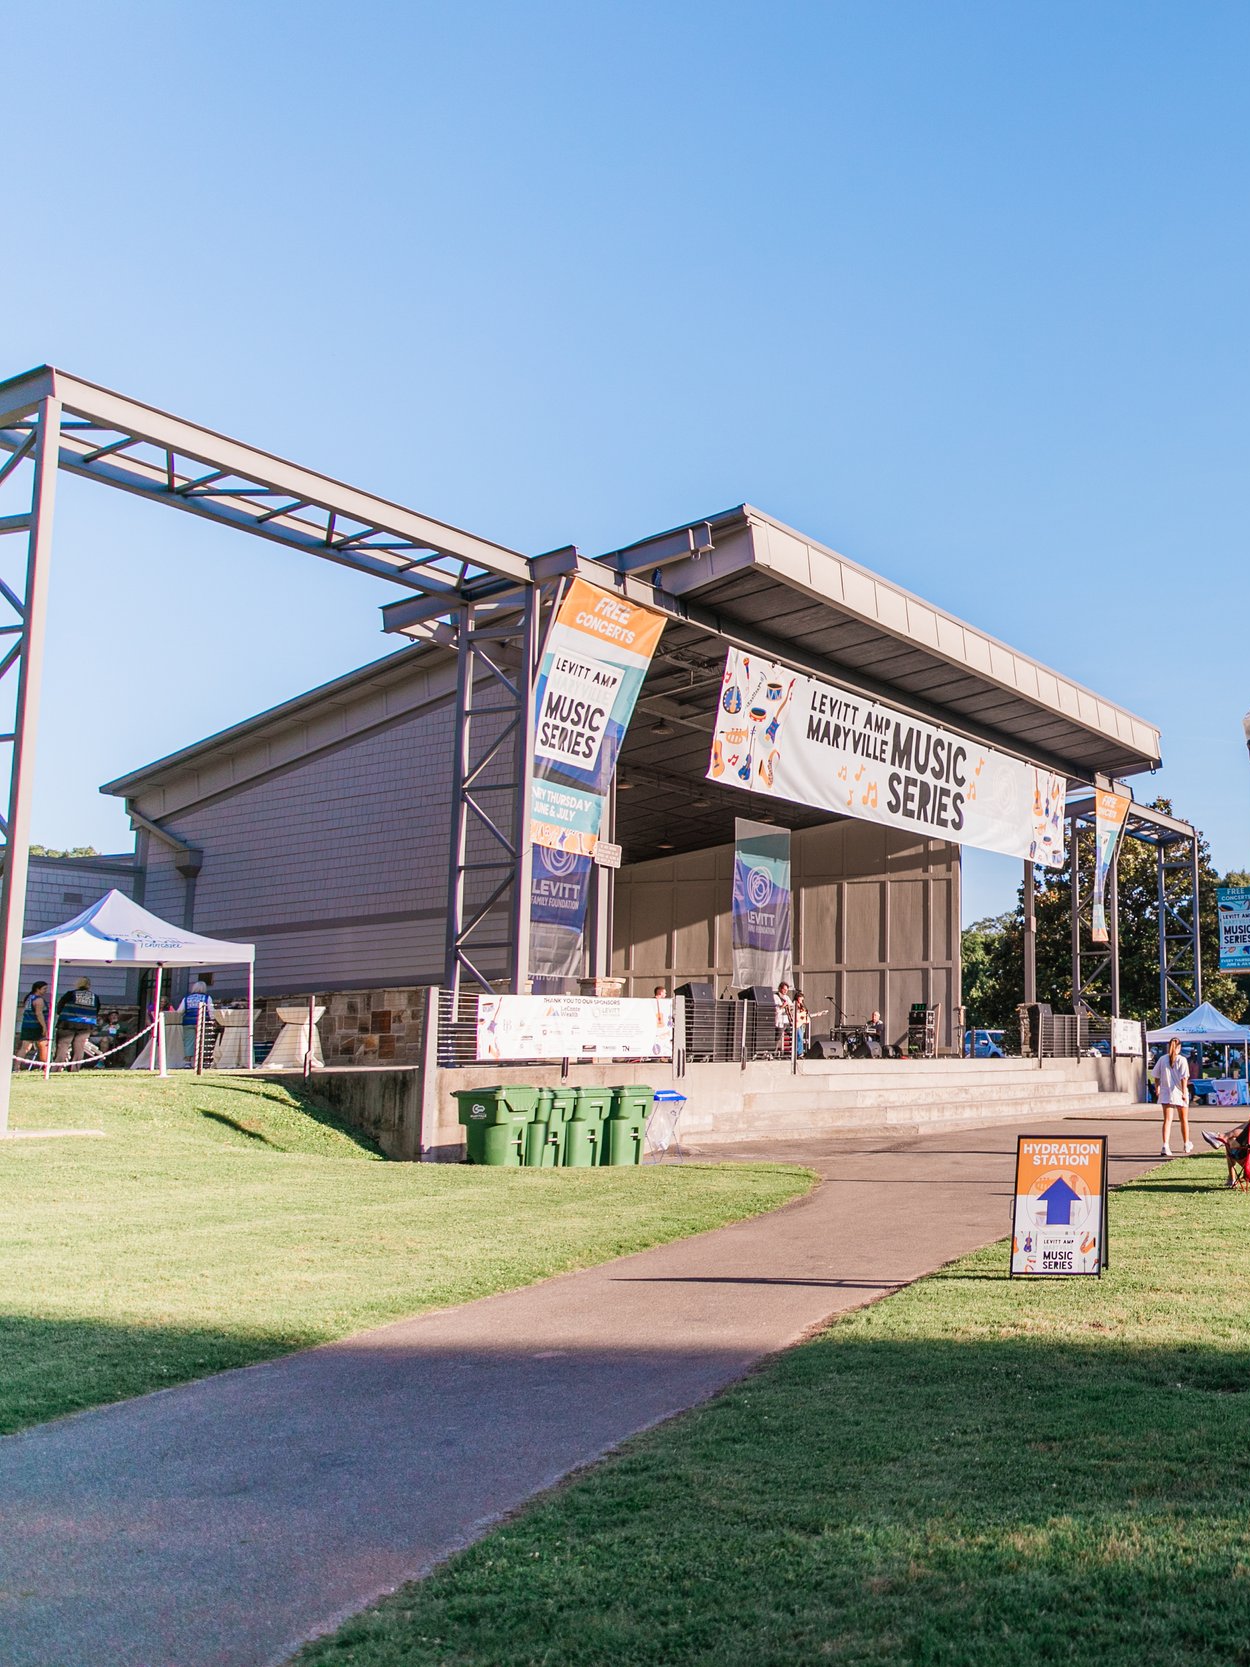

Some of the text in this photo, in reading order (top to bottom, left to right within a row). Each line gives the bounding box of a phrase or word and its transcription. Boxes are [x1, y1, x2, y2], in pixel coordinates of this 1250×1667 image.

[594, 597, 631, 625] FREE
[576, 612, 635, 644] CONCERTS
[556, 658, 617, 688] LEVITT AMP
[545, 692, 605, 732] MUSIC
[811, 691, 891, 736] LEVITT AMP
[540, 722, 596, 758] SERIES
[806, 715, 888, 763] MARYVILLE
[890, 721, 967, 788] MUSIC
[534, 800, 576, 822] JUNE & JULY
[547, 790, 592, 811] THURSDAY
[886, 772, 965, 831] SERIES
[531, 879, 580, 899] LEVITT
[549, 897, 579, 910] FOUNDATION
[748, 910, 775, 926] LEVITT
[1023, 1143, 1100, 1154] HYDRATION
[1033, 1154, 1089, 1166] STATION
[1042, 1261, 1073, 1270] SERIES
[1043, 1251, 1073, 1260] MUSIC
